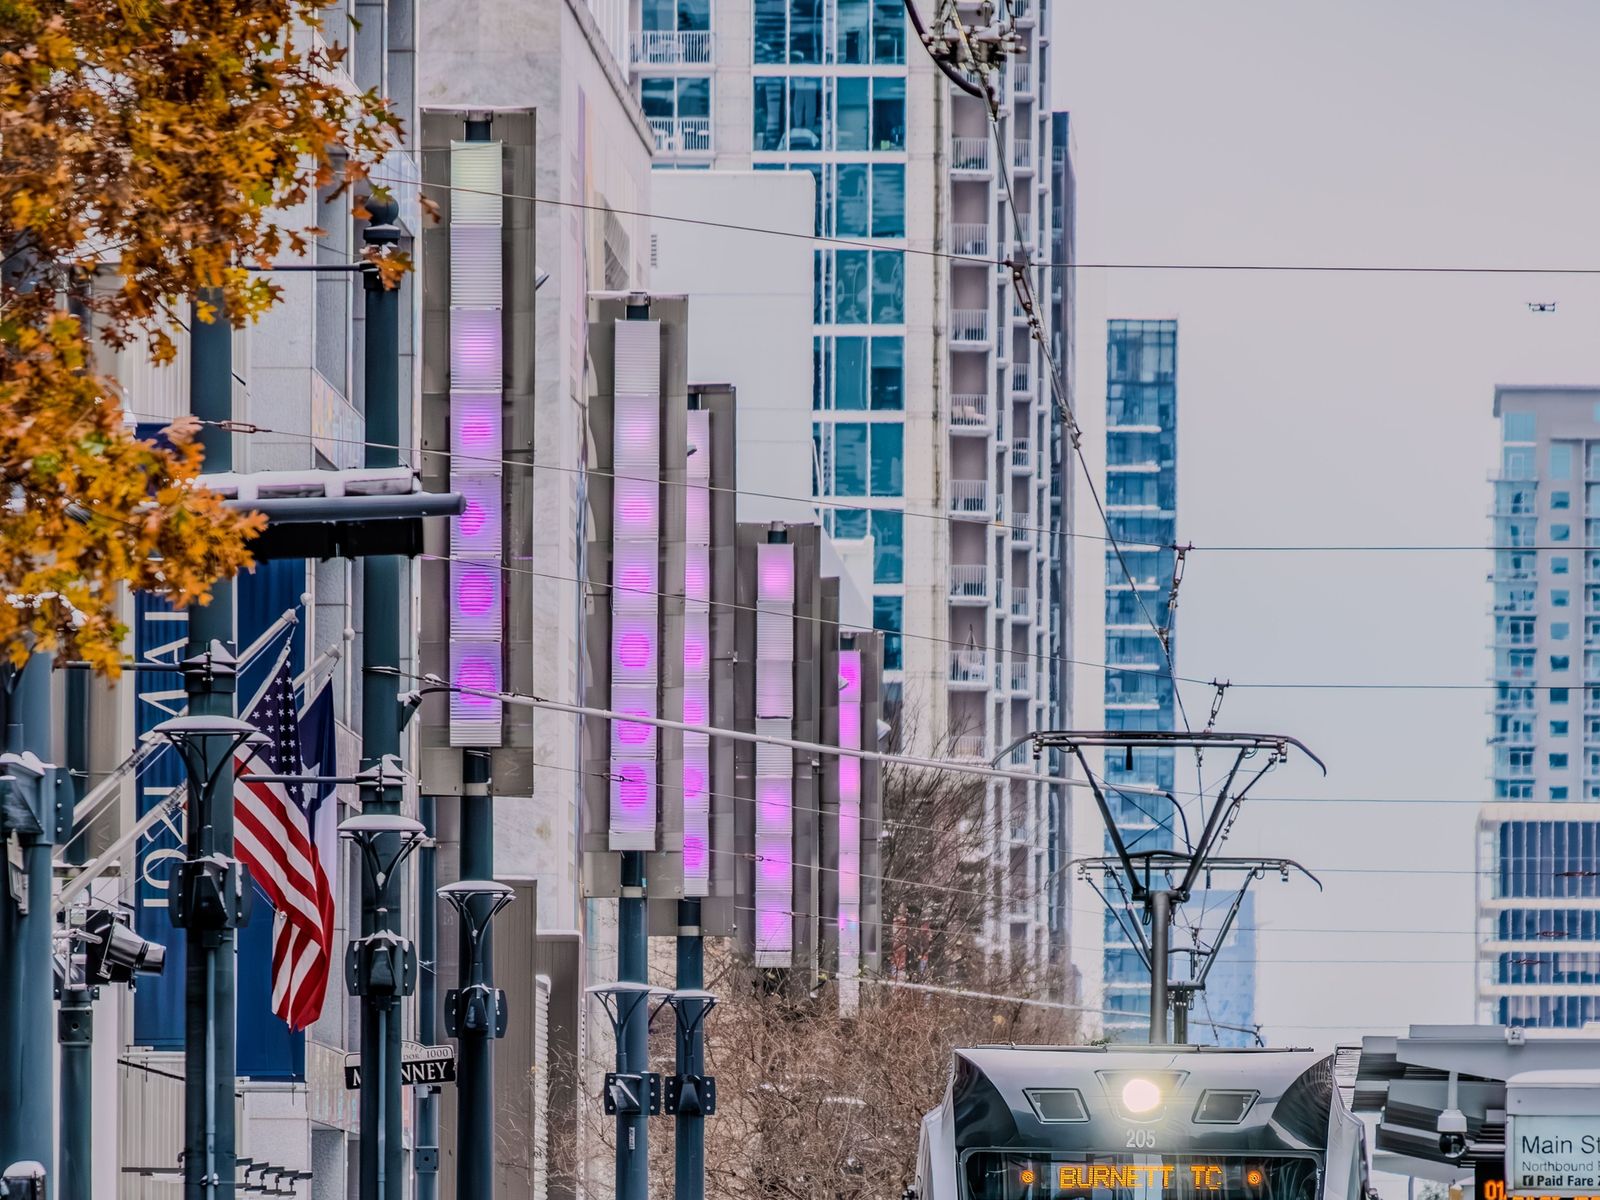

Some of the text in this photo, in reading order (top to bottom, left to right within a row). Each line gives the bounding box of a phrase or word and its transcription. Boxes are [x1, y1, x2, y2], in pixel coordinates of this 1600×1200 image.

[427, 1050, 448, 1058] 1000
[1126, 1129, 1156, 1148] 205
[1522, 1135, 1573, 1154] Main
[1522, 1161, 1594, 1172] Northbound
[1060, 1164, 1223, 1190] BURNETT TC
[1537, 1175, 1563, 1186] Paid
[1567, 1175, 1594, 1186] Fare
